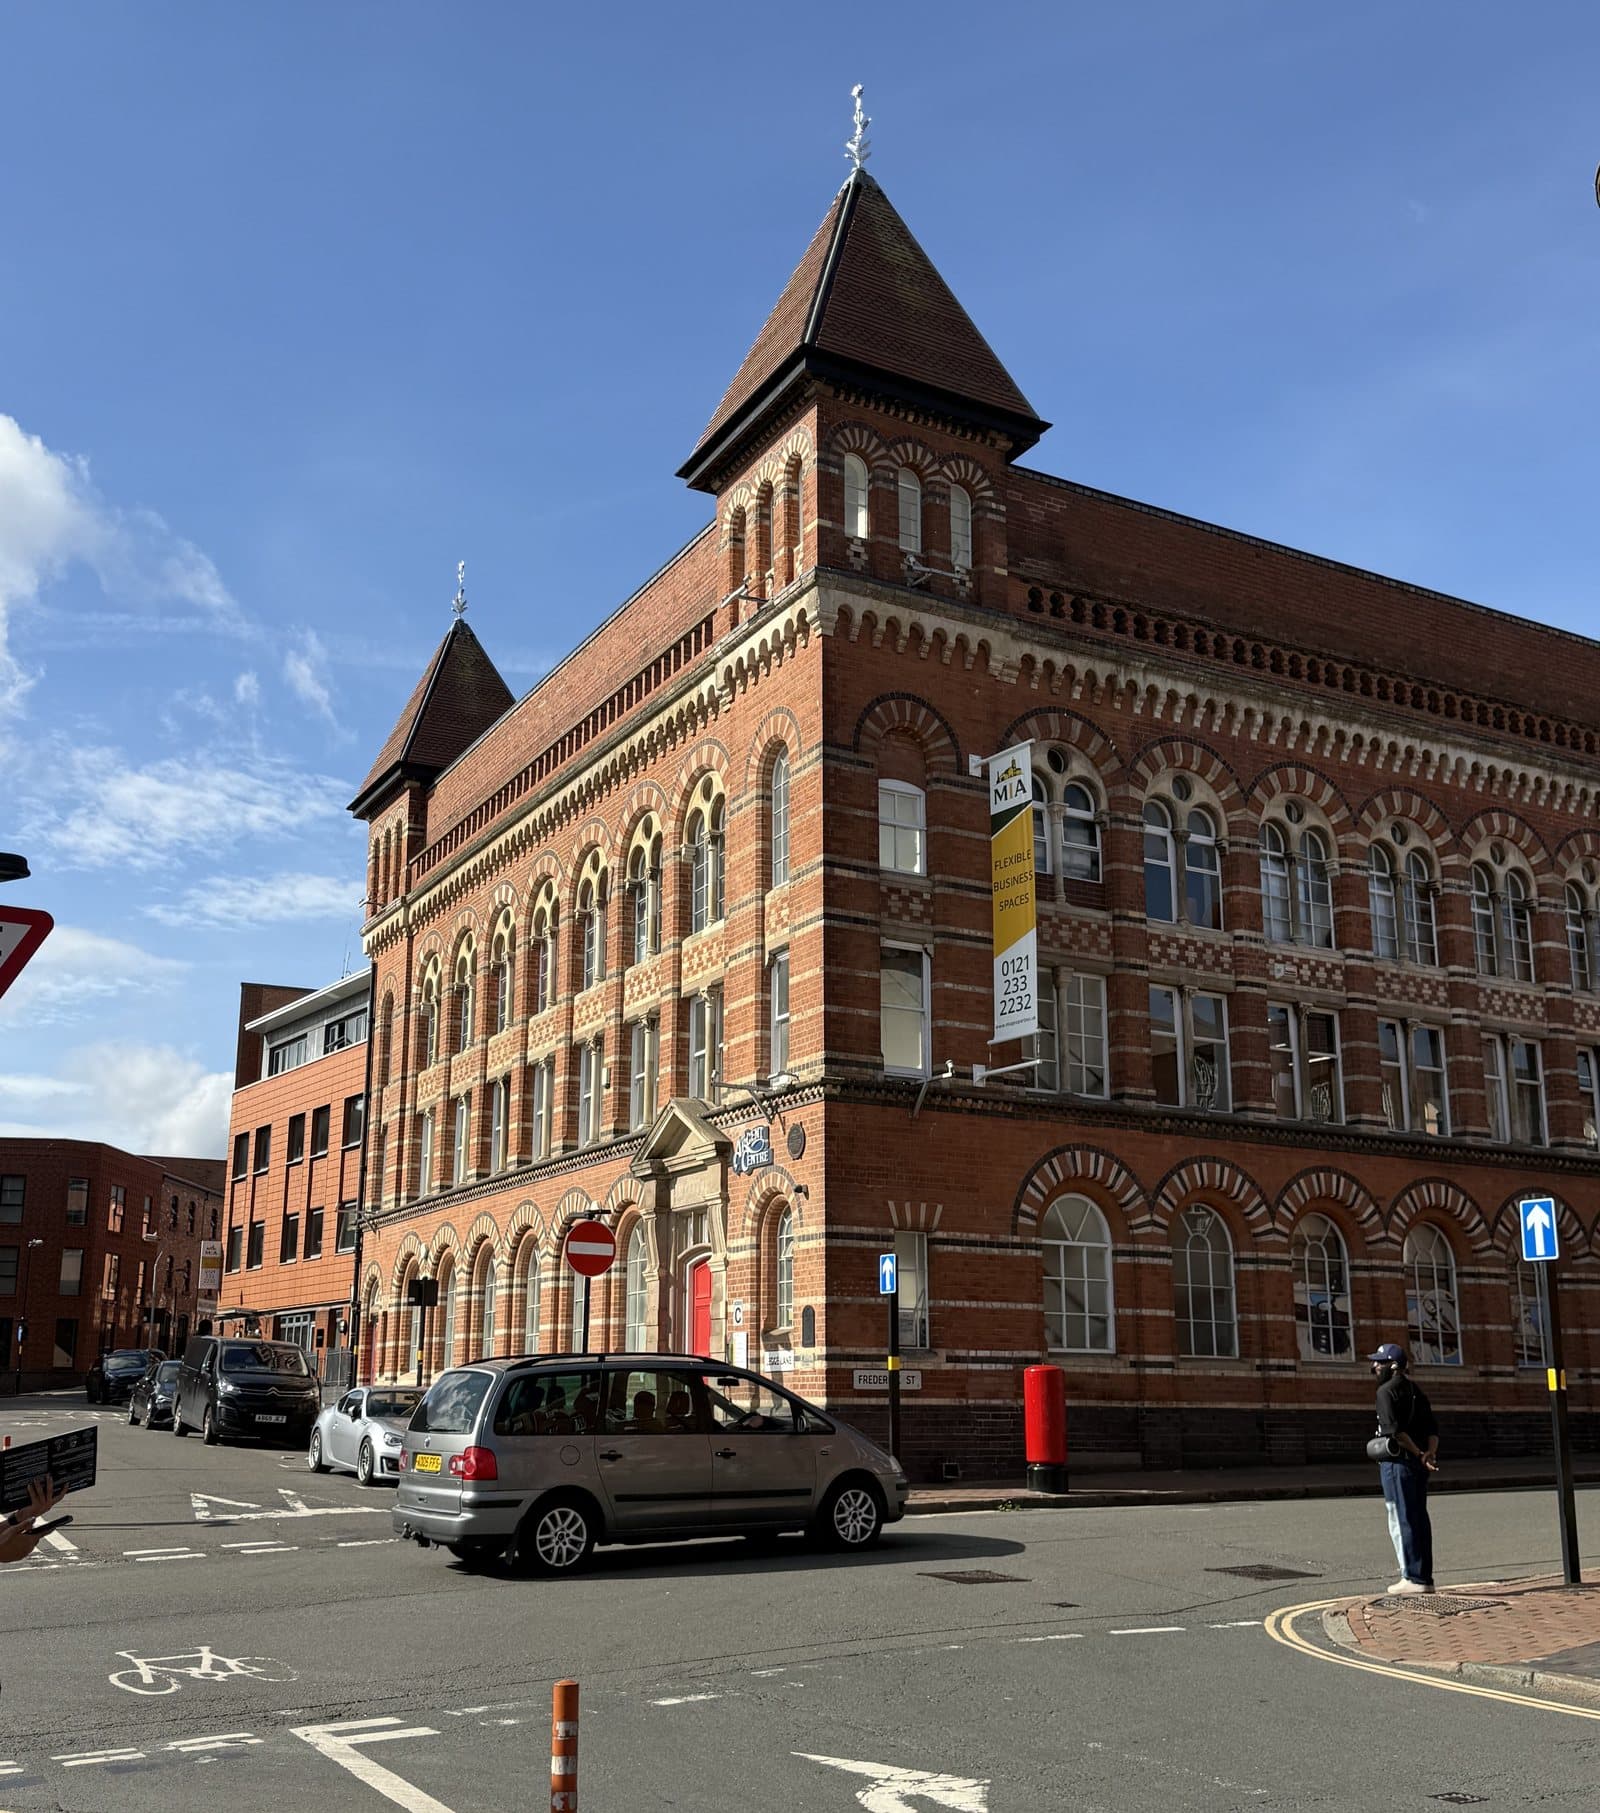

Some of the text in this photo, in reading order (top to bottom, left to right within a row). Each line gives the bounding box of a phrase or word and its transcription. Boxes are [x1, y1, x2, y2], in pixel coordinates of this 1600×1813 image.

[994, 779, 1027, 805] MIA
[995, 849, 1031, 870] FLEXIBLE
[993, 870, 1033, 892] BUSINESS
[999, 893, 1029, 911] SPACES
[1002, 954, 1028, 976] 0121
[1004, 975, 1027, 995] 233
[1000, 994, 1031, 1016] 2232
[735, 1307, 741, 1324] C
[858, 1374, 915, 1385] FREDER ST
